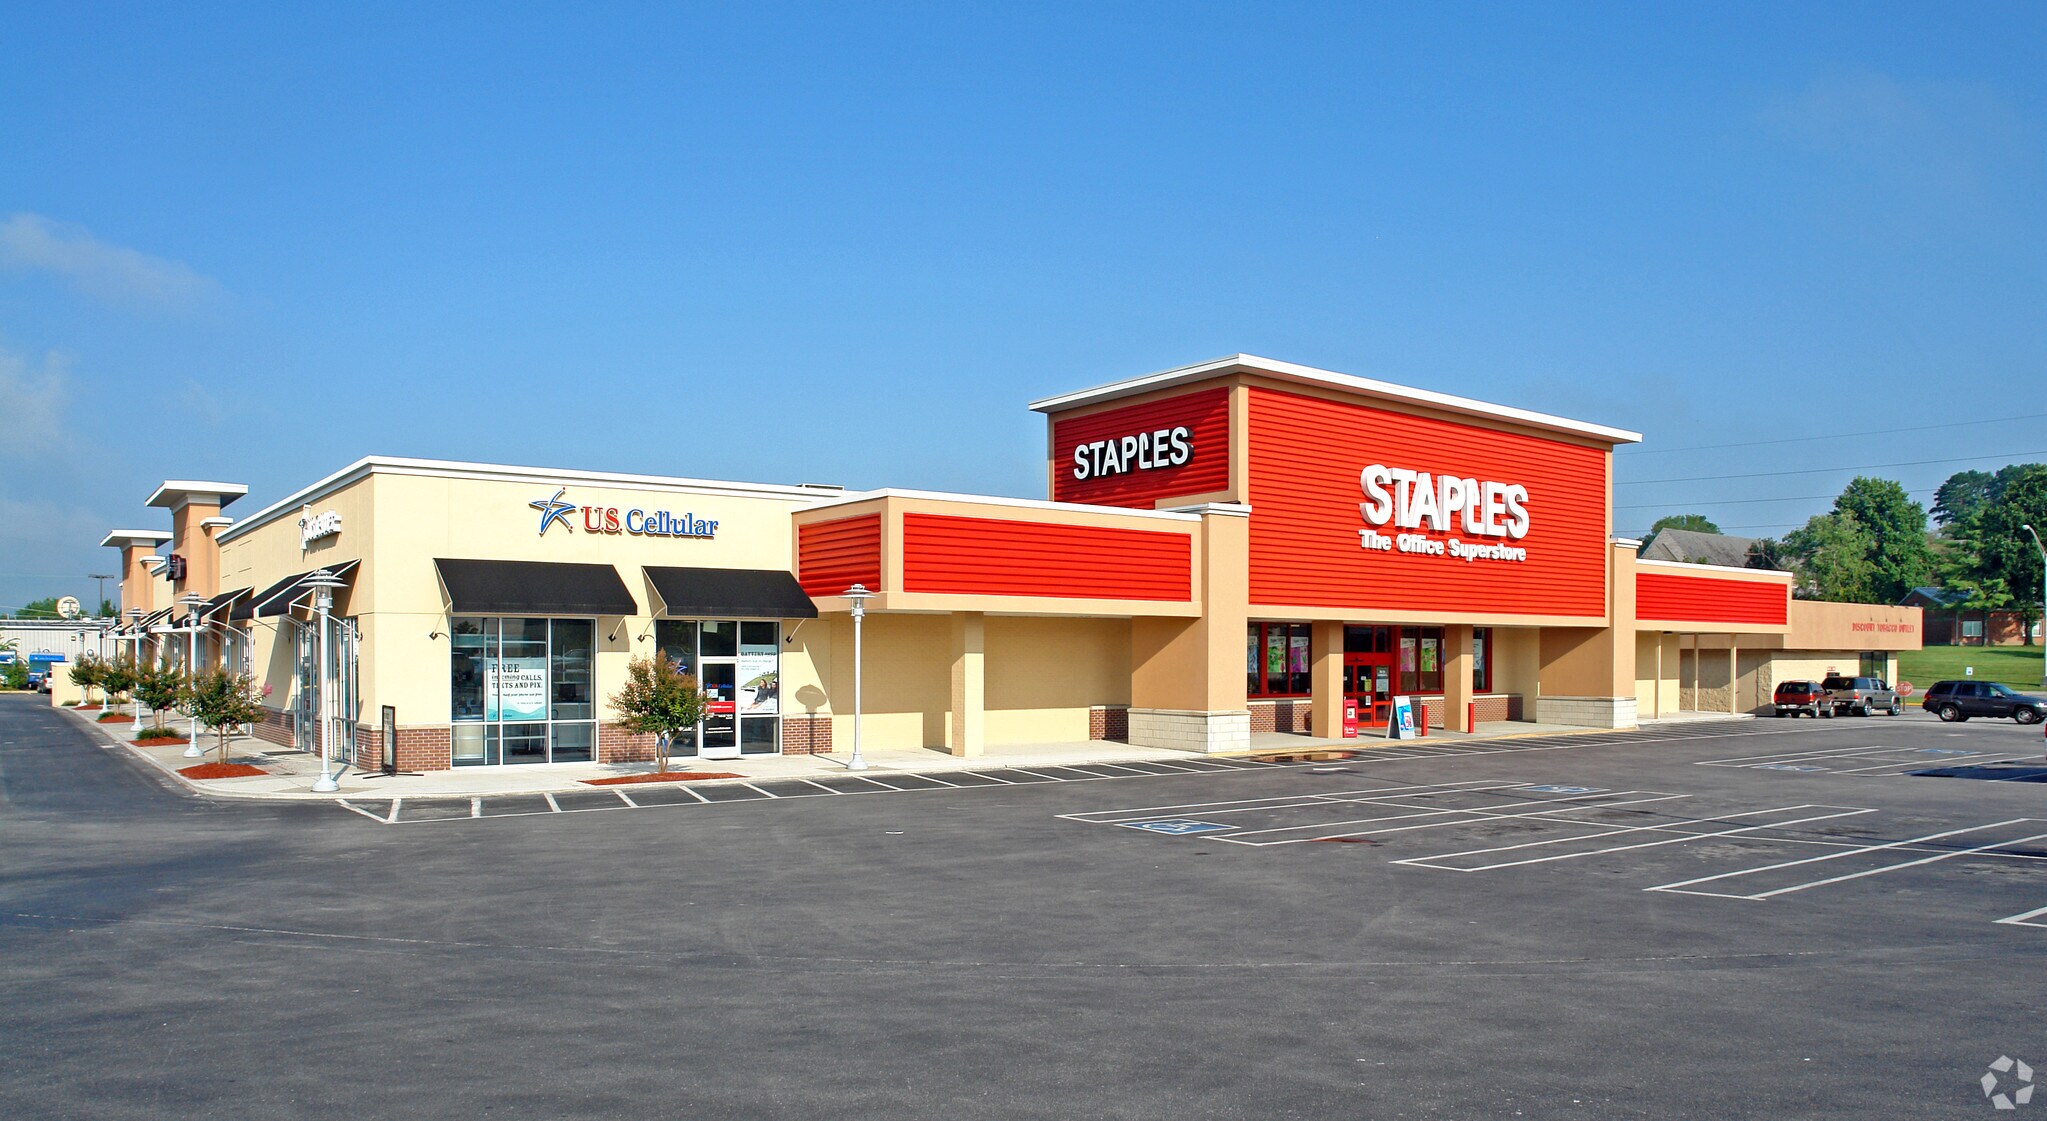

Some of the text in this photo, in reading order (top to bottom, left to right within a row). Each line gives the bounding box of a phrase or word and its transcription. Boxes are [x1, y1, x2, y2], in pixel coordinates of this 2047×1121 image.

[1073, 426, 1190, 480] STAPLES
[1359, 463, 1530, 539] STAPLES
[582, 505, 719, 537] U.S. Cellular
[1358, 529, 1527, 562] The Office Superstore
[1896, 683, 1913, 692] STOP
